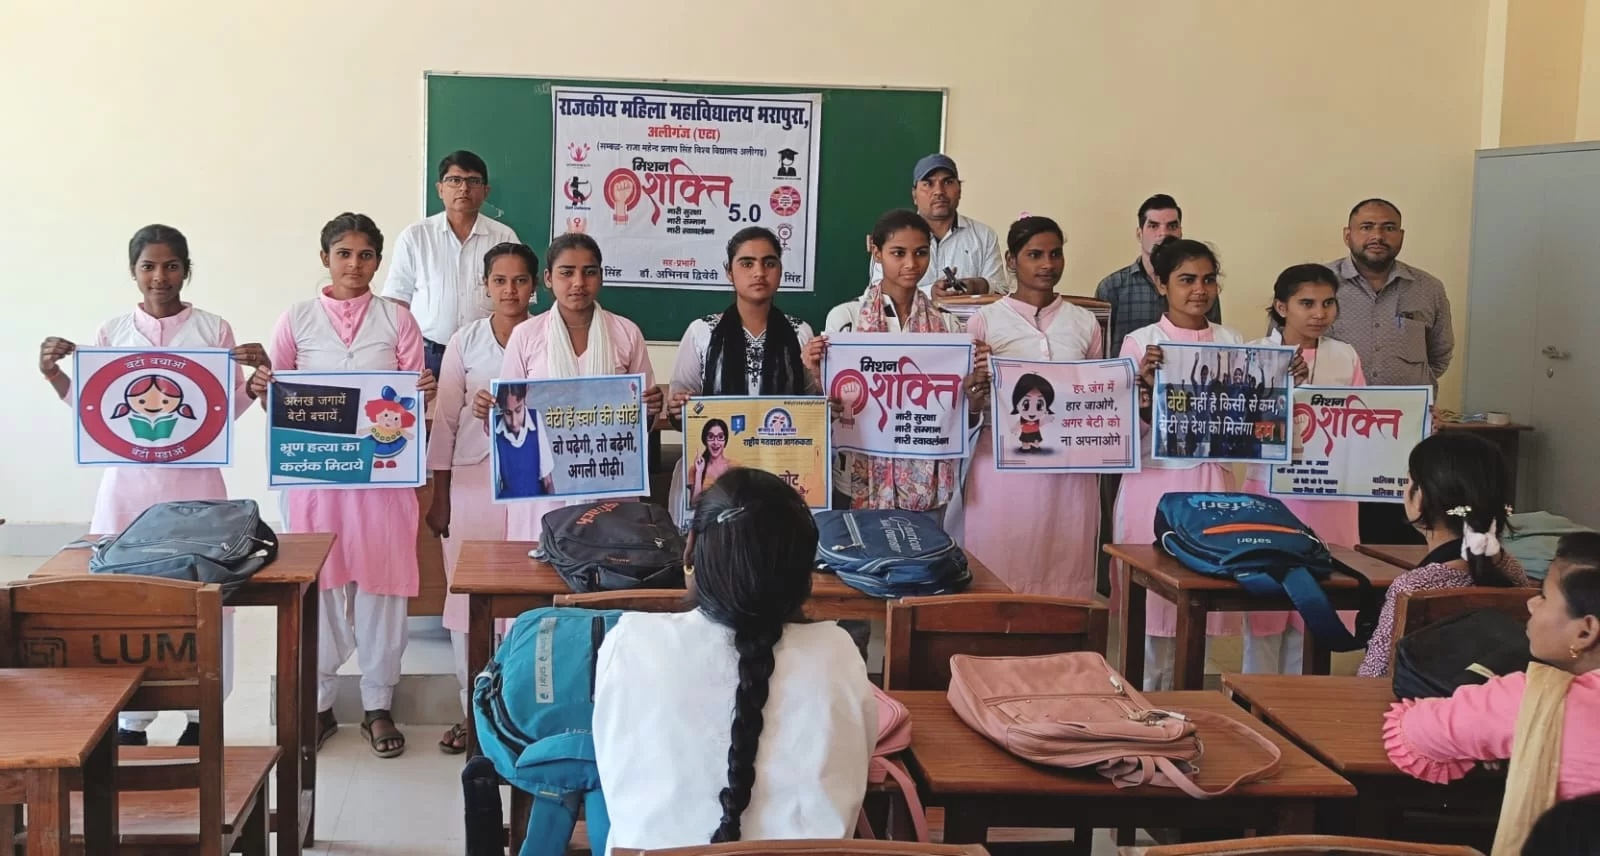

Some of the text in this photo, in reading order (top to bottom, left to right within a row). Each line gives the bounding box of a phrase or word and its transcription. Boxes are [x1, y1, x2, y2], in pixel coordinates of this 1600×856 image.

[559, 95, 809, 130] राजकीय महिला महाविद्यालय भरापुरा,
[648, 126, 721, 143] अलीगंज (एटा)
[625, 143, 640, 151] राजा
[660, 145, 678, 153] प्रताप
[679, 143, 692, 153] सिंह
[633, 157, 669, 173] मिशन
[642, 158, 733, 226] शक्ति
[667, 206, 681, 215] नारी
[728, 203, 761, 223] 5.0
[667, 216, 681, 225] नारी
[666, 225, 681, 234] नारी
[662, 257, 696, 267] सह-प्रभारी
[605, 264, 622, 278] सिंह
[656, 268, 689, 280] अभिनव
[692, 267, 718, 281] द्विवेदी
[784, 271, 802, 284] सिंह
[860, 356, 898, 373] मिशन
[869, 356, 962, 432] शक्ति
[1072, 380, 1115, 394] हर जंग में
[1065, 397, 1118, 412] हार जाओगे,
[1167, 390, 1279, 416] बेटी नहीं है किसी से कम,
[1310, 393, 1346, 407] मिशन
[287, 408, 306, 422] बेटी
[545, 406, 565, 429] बेटी
[576, 404, 598, 426] स्वर्ग
[599, 403, 614, 425] की
[895, 410, 937, 424] नारी सुरक्षा
[1061, 414, 1121, 428] अगर बेटी को
[895, 423, 941, 434] नारी सम्मान
[1159, 414, 1178, 434] बेटी
[1180, 415, 1189, 434] से
[1191, 415, 1206, 435] देश
[1208, 416, 1221, 435] को
[1222, 416, 1254, 436] मिलेगा
[1317, 394, 1404, 457] शक्ति
[552, 435, 564, 455] वो
[596, 433, 608, 453] तो
[894, 434, 911, 445] नारी
[1060, 432, 1121, 447] ना अपनाओगे
[280, 442, 360, 457] भ्रूण हत्या का
[279, 458, 364, 472] कलंक मिटाये
[568, 457, 597, 479] अगली
